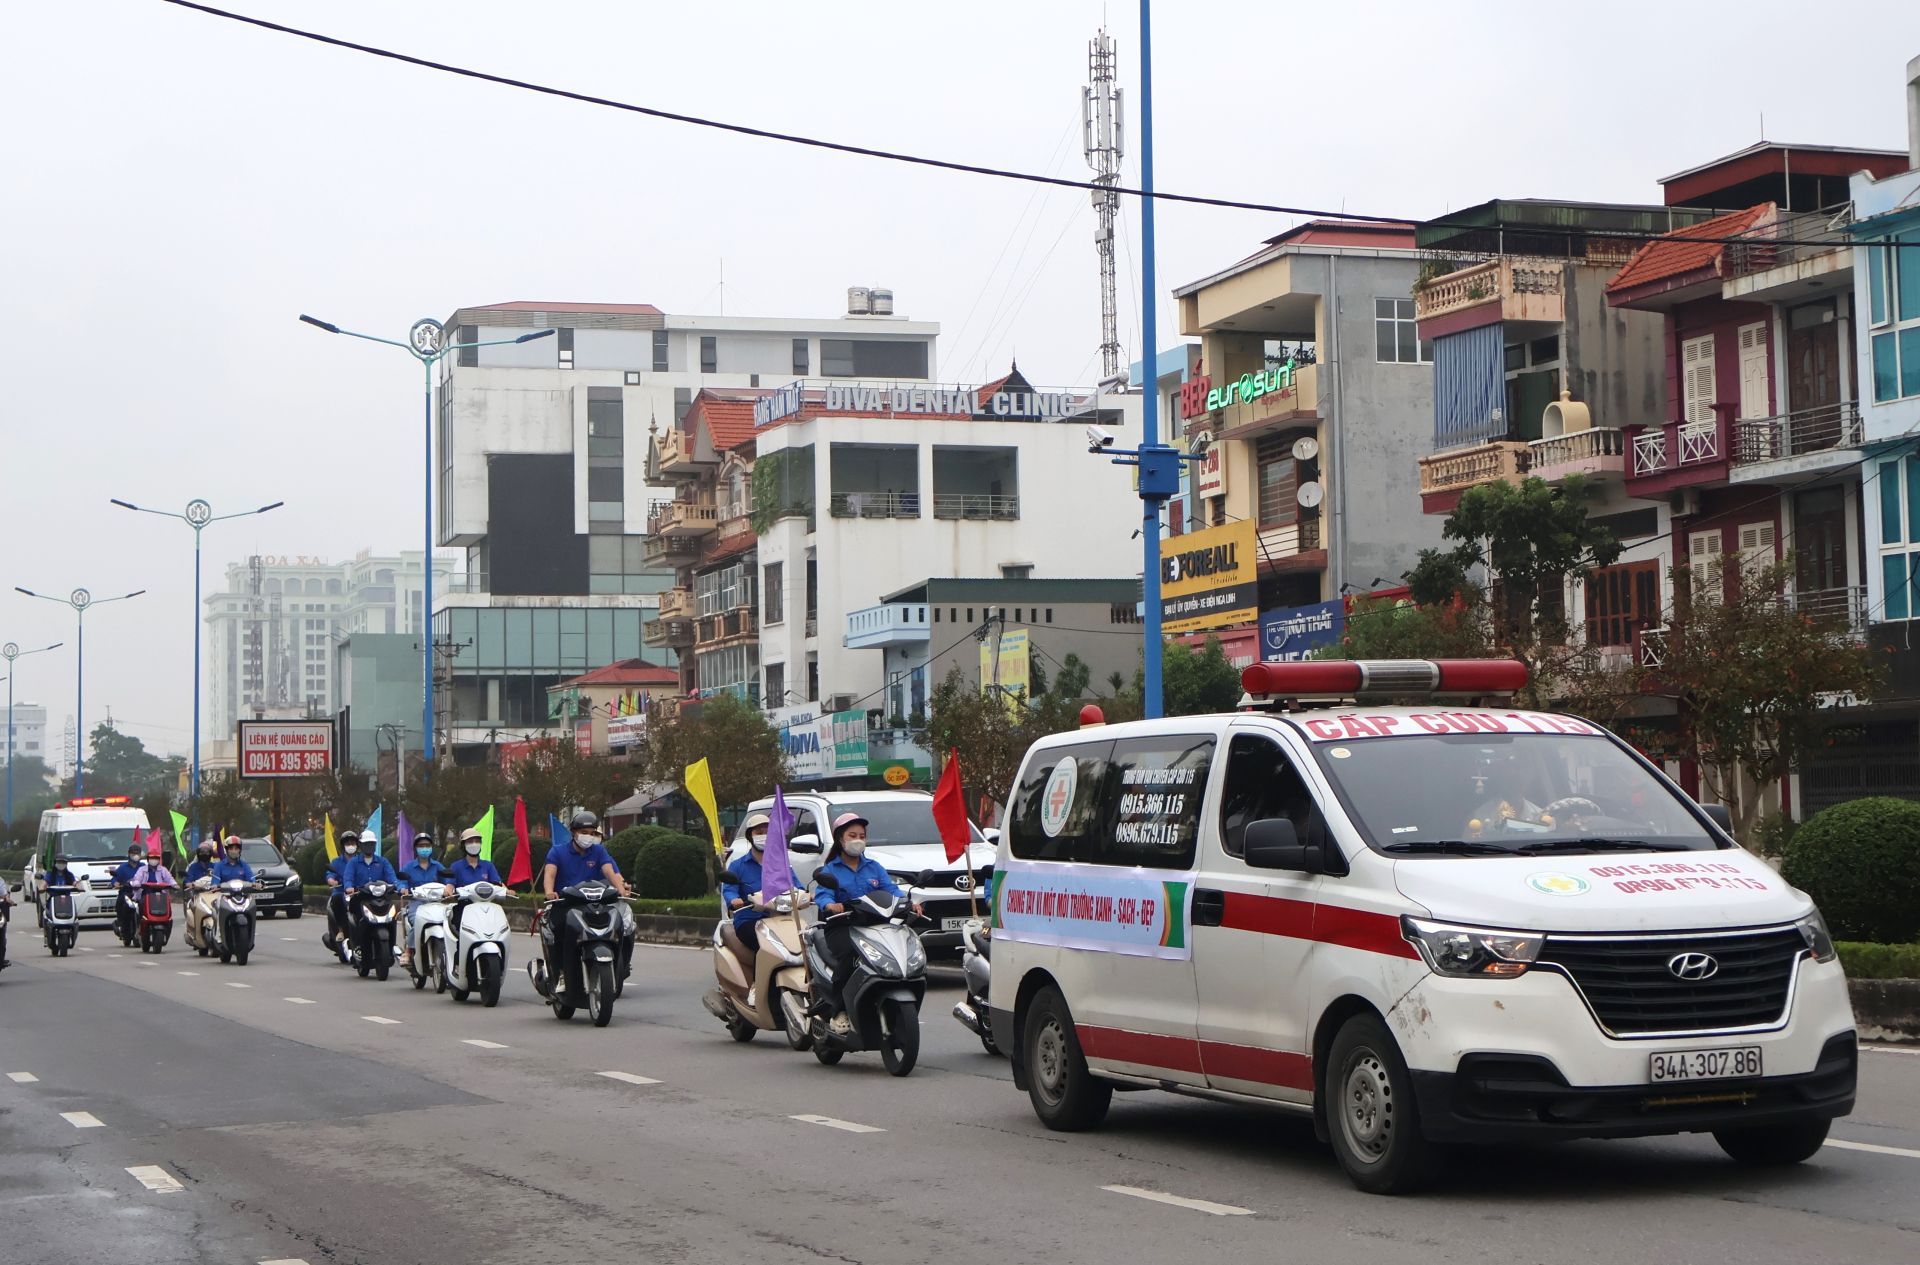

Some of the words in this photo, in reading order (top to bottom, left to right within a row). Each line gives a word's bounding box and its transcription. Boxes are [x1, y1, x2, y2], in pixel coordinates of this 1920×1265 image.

[826, 386, 883, 412] DIVA
[891, 388, 986, 416] DENTAL
[993, 392, 1076, 417] CLINIC
[250, 732, 266, 744] LIÊN
[269, 732, 278, 747] HỆ
[280, 730, 306, 744] QUẢNG
[790, 732, 820, 756] DIVA
[250, 752, 276, 770] 0941
[280, 752, 300, 770] 395
[304, 752, 324, 770] 395
[1120, 794, 1164, 814] 0915.366
[1165, 794, 1184, 814] 115
[1116, 822, 1179, 844] 0896.679.115
[1589, 863, 1740, 878] 0915.366.115
[1007, 889, 1025, 913] CHUNG
[1026, 890, 1035, 915] TAY
[1043, 887, 1056, 922] MỘT
[1057, 888, 1070, 918] MÔI
[1094, 896, 1112, 922] XANH
[1118, 899, 1136, 929] SẠCH
[1141, 899, 1154, 932] ĐẸP
[1654, 1050, 1757, 1079] 34A-307.86
